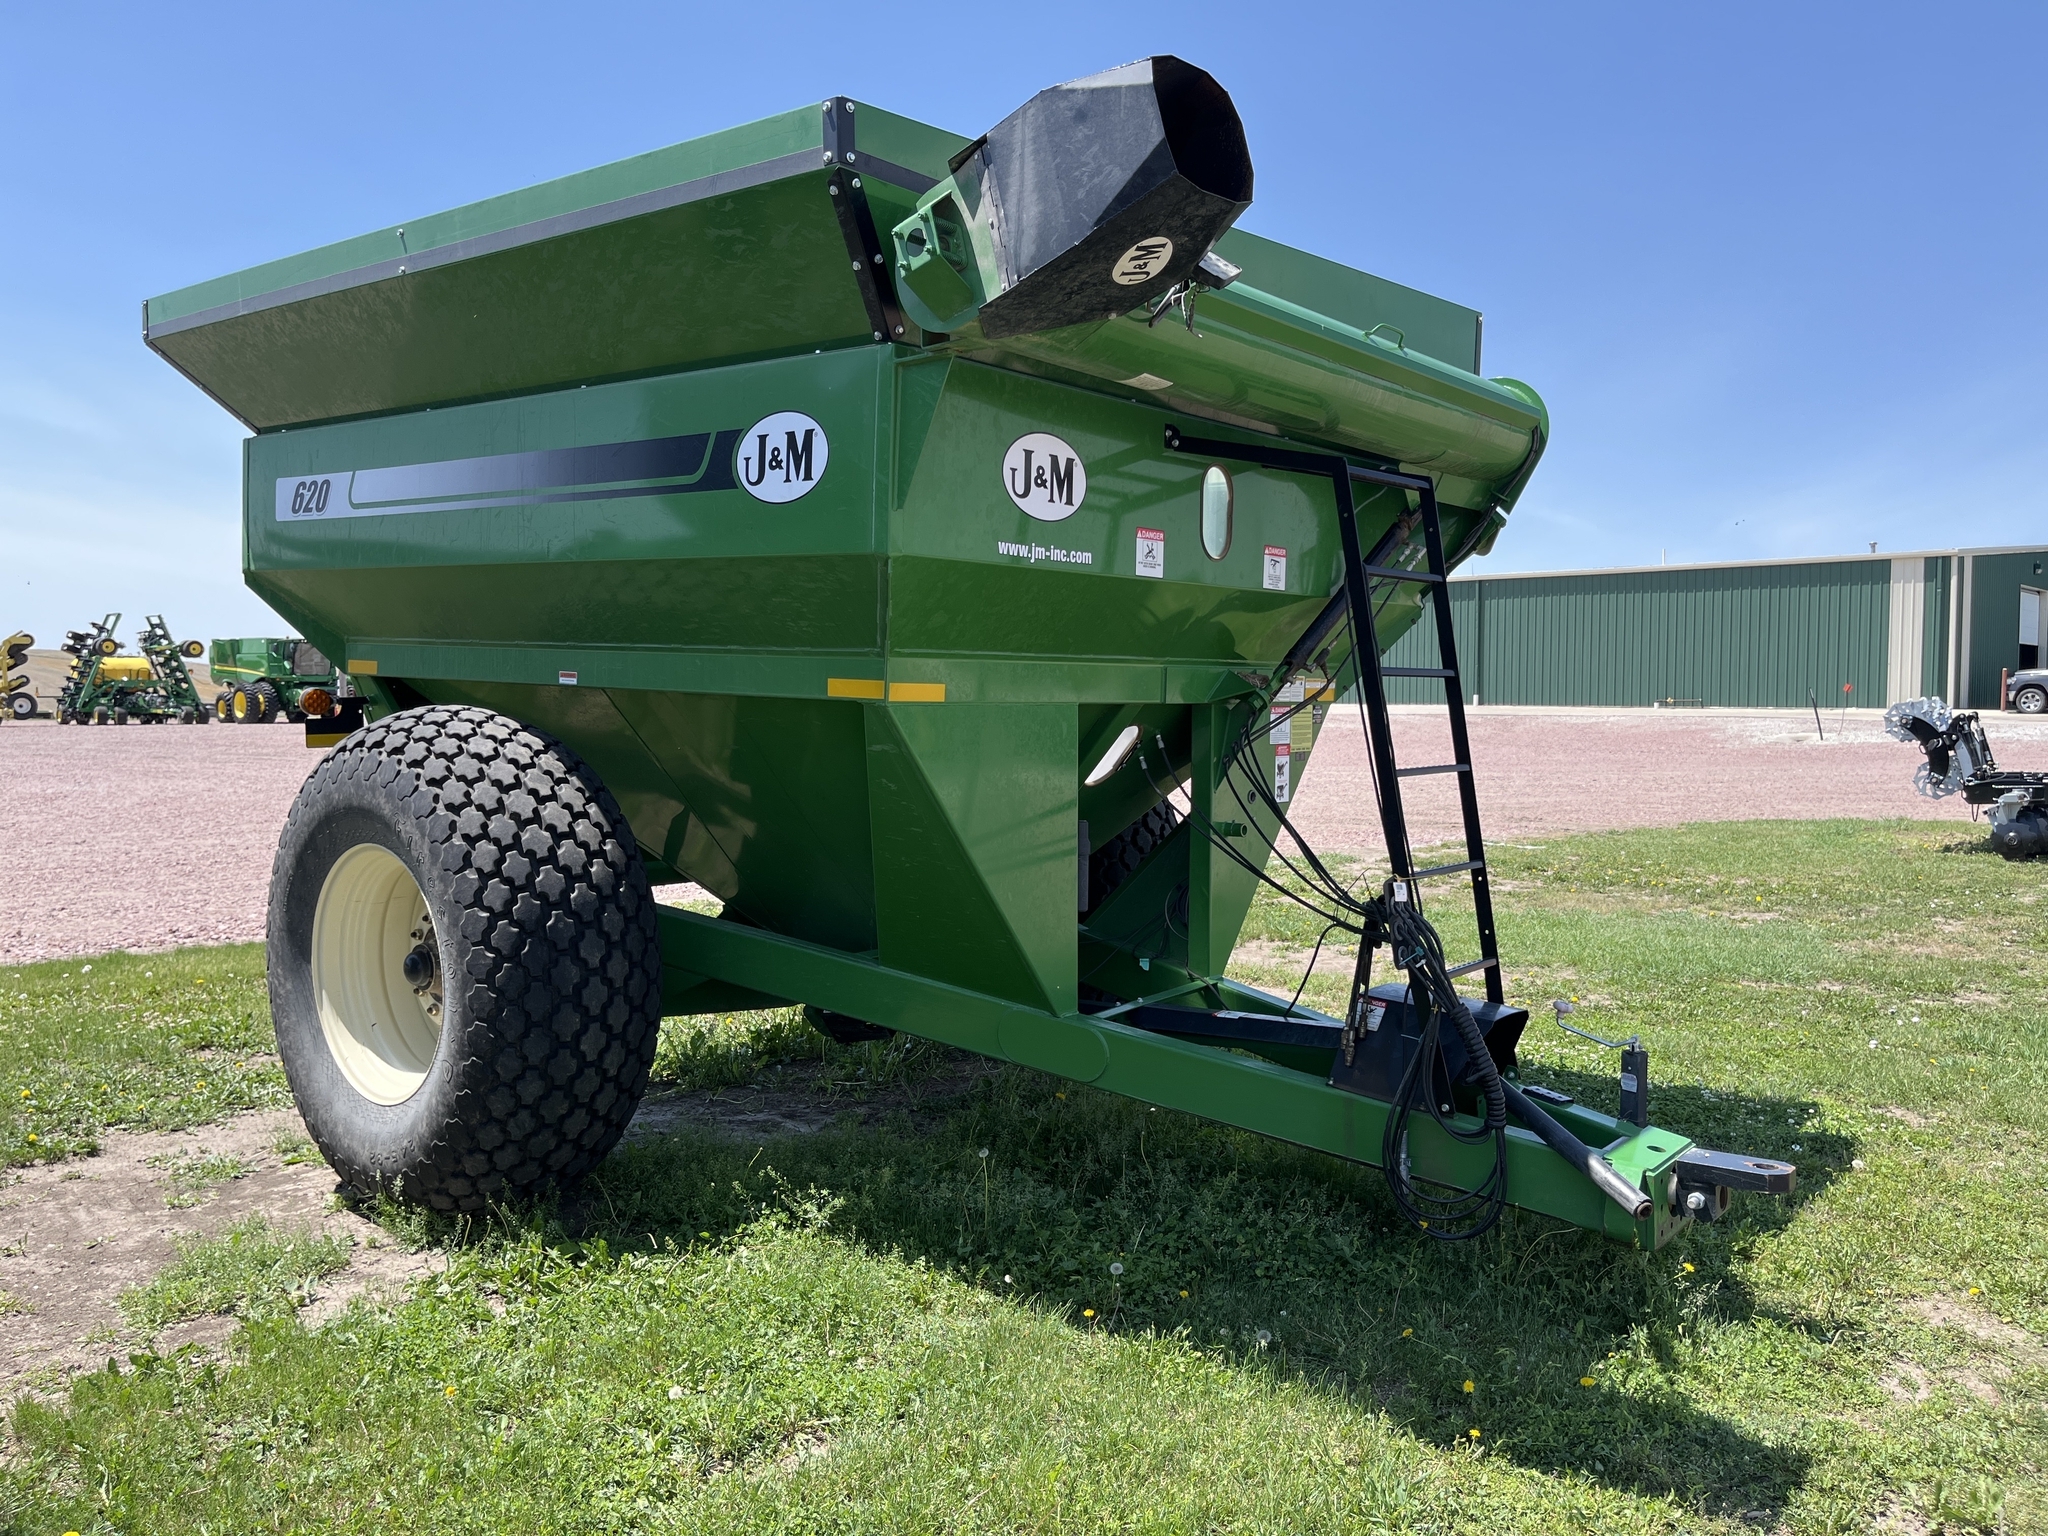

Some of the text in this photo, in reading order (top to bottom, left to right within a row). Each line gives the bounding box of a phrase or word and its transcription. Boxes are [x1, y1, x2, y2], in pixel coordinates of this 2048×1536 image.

[1119, 242, 1168, 283] J&M
[743, 428, 816, 487] J&M
[1009, 448, 1076, 507] J&M
[291, 479, 331, 516] 620
[998, 541, 1092, 564] www.jm-inc.com
[1141, 530, 1164, 540] DANGER
